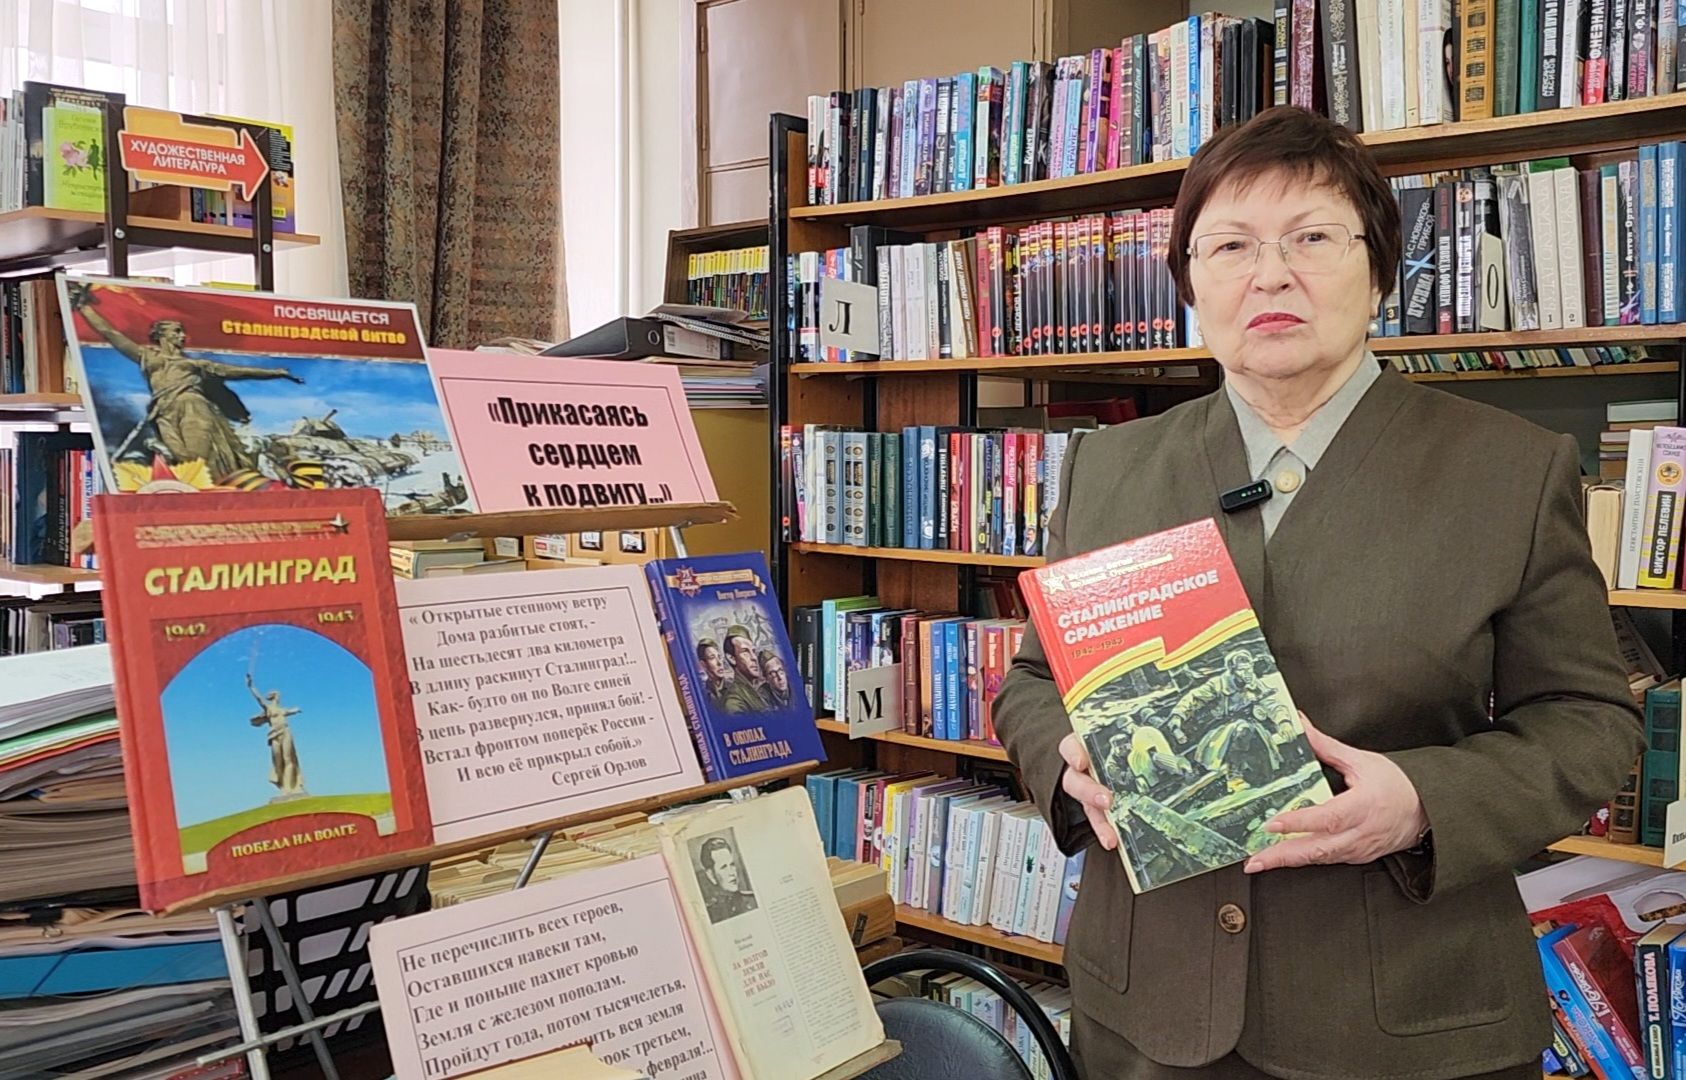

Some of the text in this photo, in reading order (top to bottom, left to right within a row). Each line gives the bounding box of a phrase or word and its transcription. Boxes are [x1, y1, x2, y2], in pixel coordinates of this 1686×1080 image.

[130, 140, 245, 166] ХУДОЖЕСТВЕННАЯ
[152, 156, 228, 176] ЛИТЕРАТУРА
[1418, 215, 1436, 250] ПРИБОЙ
[1625, 232, 1634, 262] Антон
[1440, 236, 1450, 272] ИСПОВЕДЬ
[1407, 272, 1434, 318] ЦУСИМА
[1440, 274, 1451, 307] ОФИЦЕРА
[222, 320, 358, 342] Сталинградской
[274, 304, 390, 324] ПОСВЯЩАЕТСЯ
[829, 300, 852, 335] Л
[1387, 308, 1396, 318] 3
[488, 396, 648, 428] «Прикасаясь
[528, 443, 642, 470] сердцем
[1630, 458, 1644, 552] КОНСТАНТИН ПАУСТОВСКИЙ
[1654, 494, 1673, 574] ВИКТОР ПЕЛЕВИН
[145, 556, 356, 596] СТАЛИНГРАД
[422, 606, 502, 626] Открытые
[506, 600, 568, 618] степному
[572, 596, 607, 611] ветру
[1058, 570, 1220, 629] СТАЛИНГРАДСКОЕ
[436, 627, 476, 648] Дома
[480, 620, 545, 643] разбитые
[549, 616, 588, 633] стоят,
[1064, 604, 1164, 646] СРАЖЕНИЕ
[412, 634, 624, 672] На шестьдесят два километра
[410, 652, 638, 696] В длину раскинут Сталинград!..
[427, 674, 632, 717] Как- будто он по Волге синей
[678, 673, 700, 731] СТАЛИНГРАДА
[857, 687, 884, 723] М
[428, 724, 466, 744] цепь
[470, 709, 564, 738] развернулся,
[566, 700, 616, 719] принял
[618, 690, 644, 708] бой!
[424, 746, 471, 766] Встал
[474, 736, 539, 759] фронтом
[543, 722, 598, 746] поперёк
[601, 714, 646, 733] России
[723, 726, 766, 748] В ОКОПАХ
[730, 740, 792, 765] СТАЛИНГРАДА
[457, 736, 643, 783] И всю её прикрыл собой.»
[551, 756, 648, 786] Сергей Орлов
[232, 824, 357, 858] ПОБЕДА НА ВОЛГЕ
[402, 902, 624, 973] Не перечислить всех героев,
[407, 931, 606, 998] Оставшихся навеки там,
[413, 944, 639, 1026] Где и поныне пахнет кровью
[1644, 952, 1660, 1022] Т. ПОЛЯКОВА
[420, 976, 626, 1050] Земля с железом пополам.
[425, 1040, 502, 1077] Пройдут
[506, 1030, 544, 1050] года,
[547, 1011, 592, 1036] потом
[595, 980, 686, 1015] тысячелетья,
[619, 1002, 684, 1037] вся земля
[632, 1026, 692, 1055] третьем,
[647, 1040, 713, 1079] февраля!..
